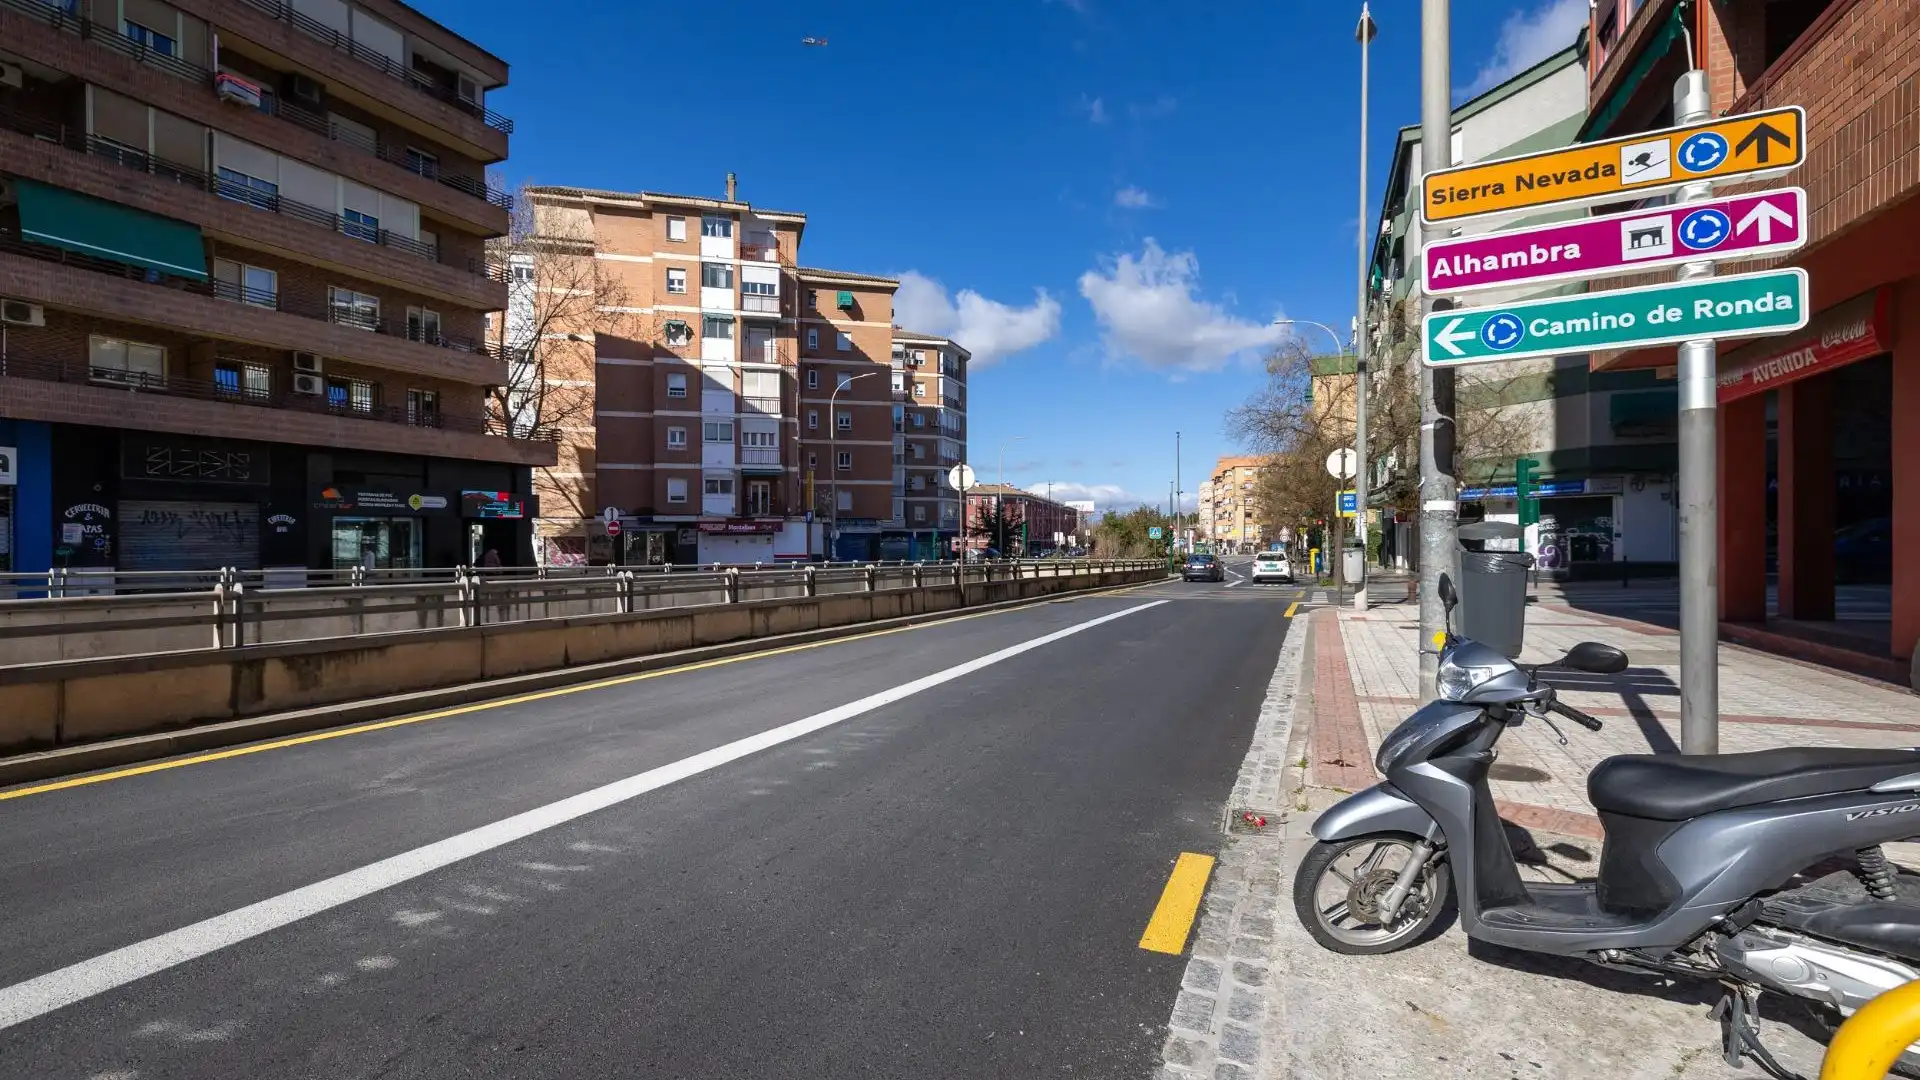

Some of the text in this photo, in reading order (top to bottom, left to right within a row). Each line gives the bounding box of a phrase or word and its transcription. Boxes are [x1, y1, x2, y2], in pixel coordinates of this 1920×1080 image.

[1432, 161, 1617, 205] Sierra Nevada
[1432, 243, 1582, 279] Alhambra
[1529, 291, 1793, 337] Camino de Ronda
[1751, 347, 1819, 385] AVENIDA
[79, 524, 103, 533] APAS
